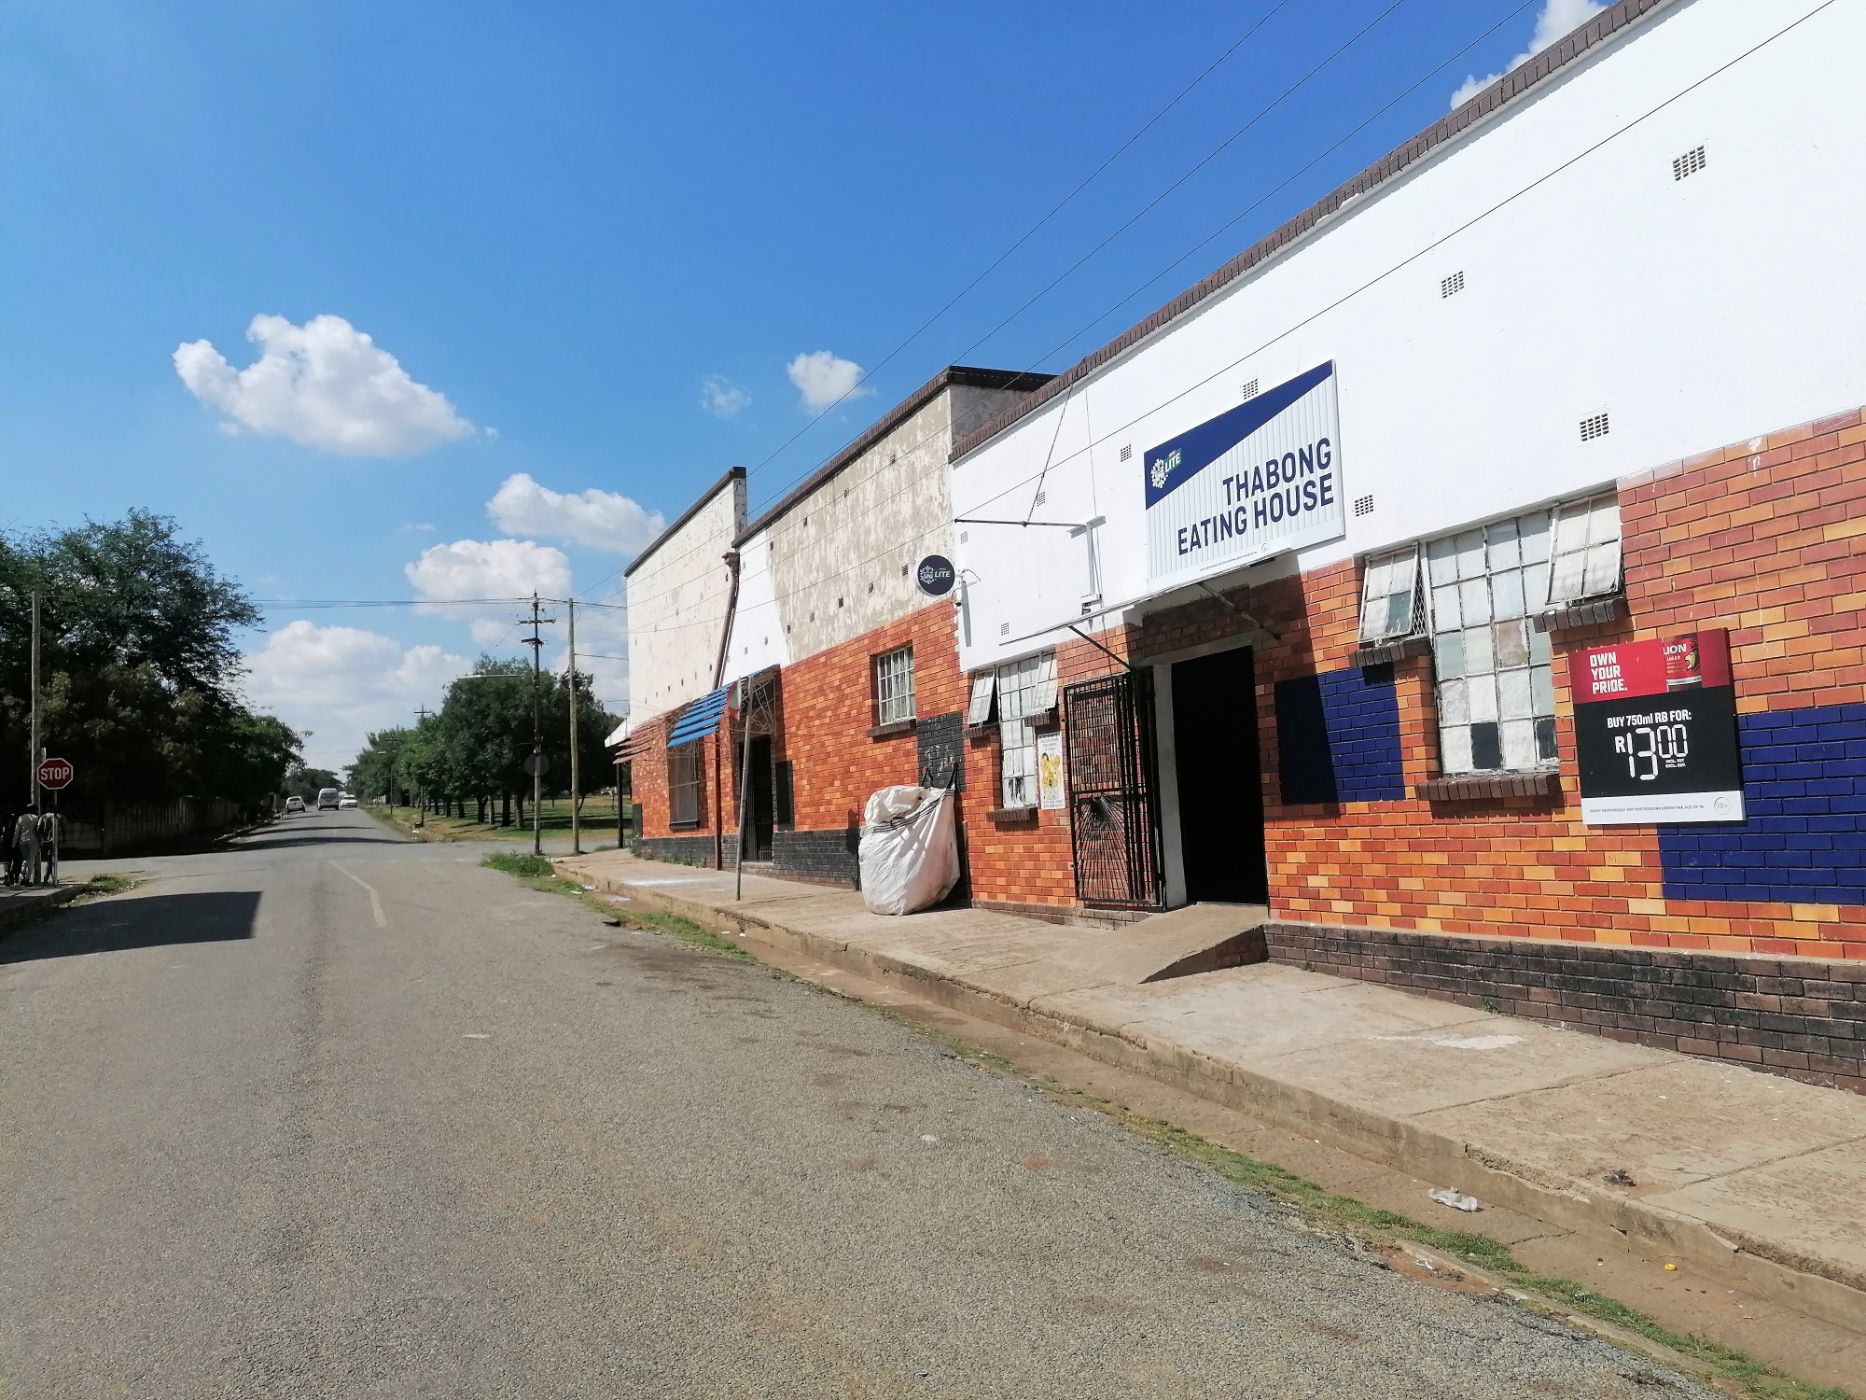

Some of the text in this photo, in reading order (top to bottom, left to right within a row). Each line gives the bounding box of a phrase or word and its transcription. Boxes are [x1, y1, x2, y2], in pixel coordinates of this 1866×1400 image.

[1165, 450, 1181, 473] LITE
[1222, 437, 1332, 506] THABONG
[1177, 472, 1334, 556] EATING HOUSE
[934, 570, 951, 578] LITE
[1663, 643, 1687, 655] LION
[1589, 651, 1617, 667] OWN
[1591, 664, 1622, 681] YOUR
[1592, 678, 1628, 695] PRIDE.
[1607, 708, 1692, 729] BUY 750ml RB FOR:
[40, 767, 70, 780] STOP
